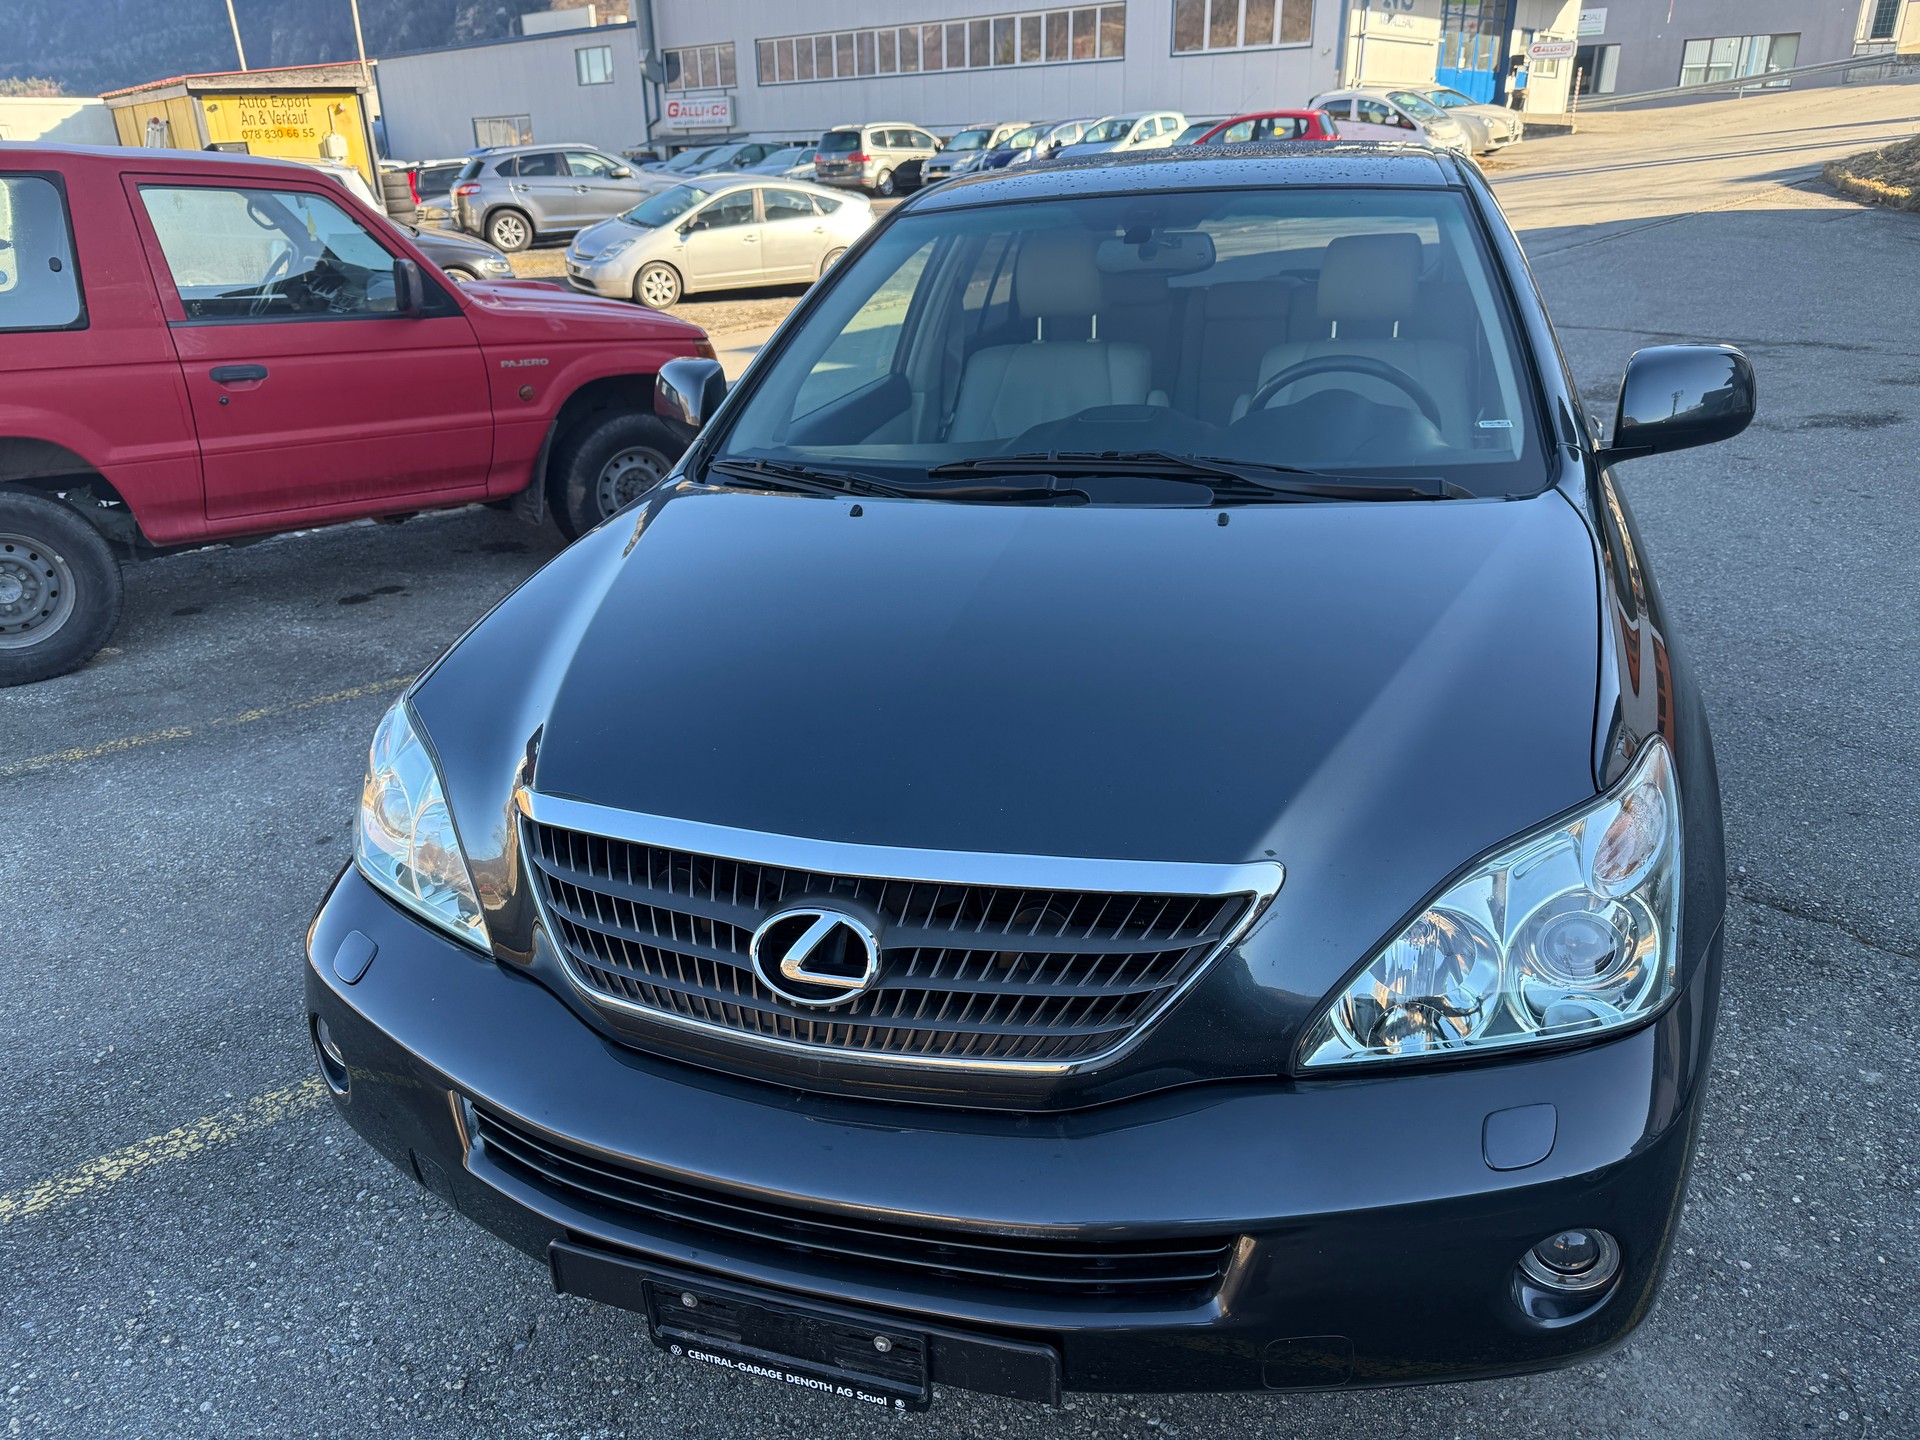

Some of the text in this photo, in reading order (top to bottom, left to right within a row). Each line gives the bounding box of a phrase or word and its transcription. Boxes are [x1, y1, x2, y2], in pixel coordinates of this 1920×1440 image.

[239, 95, 312, 110] Auto Export
[241, 109, 309, 126] An & Verkauf
[242, 128, 315, 140] 078 830 66 55
[500, 358, 549, 368] PAJERO
[687, 1349, 783, 1381] CENTRAL-GARAGE
[786, 1373, 833, 1393] DENOTH
[836, 1385, 853, 1398] AG
[856, 1390, 887, 1406] Scuol
